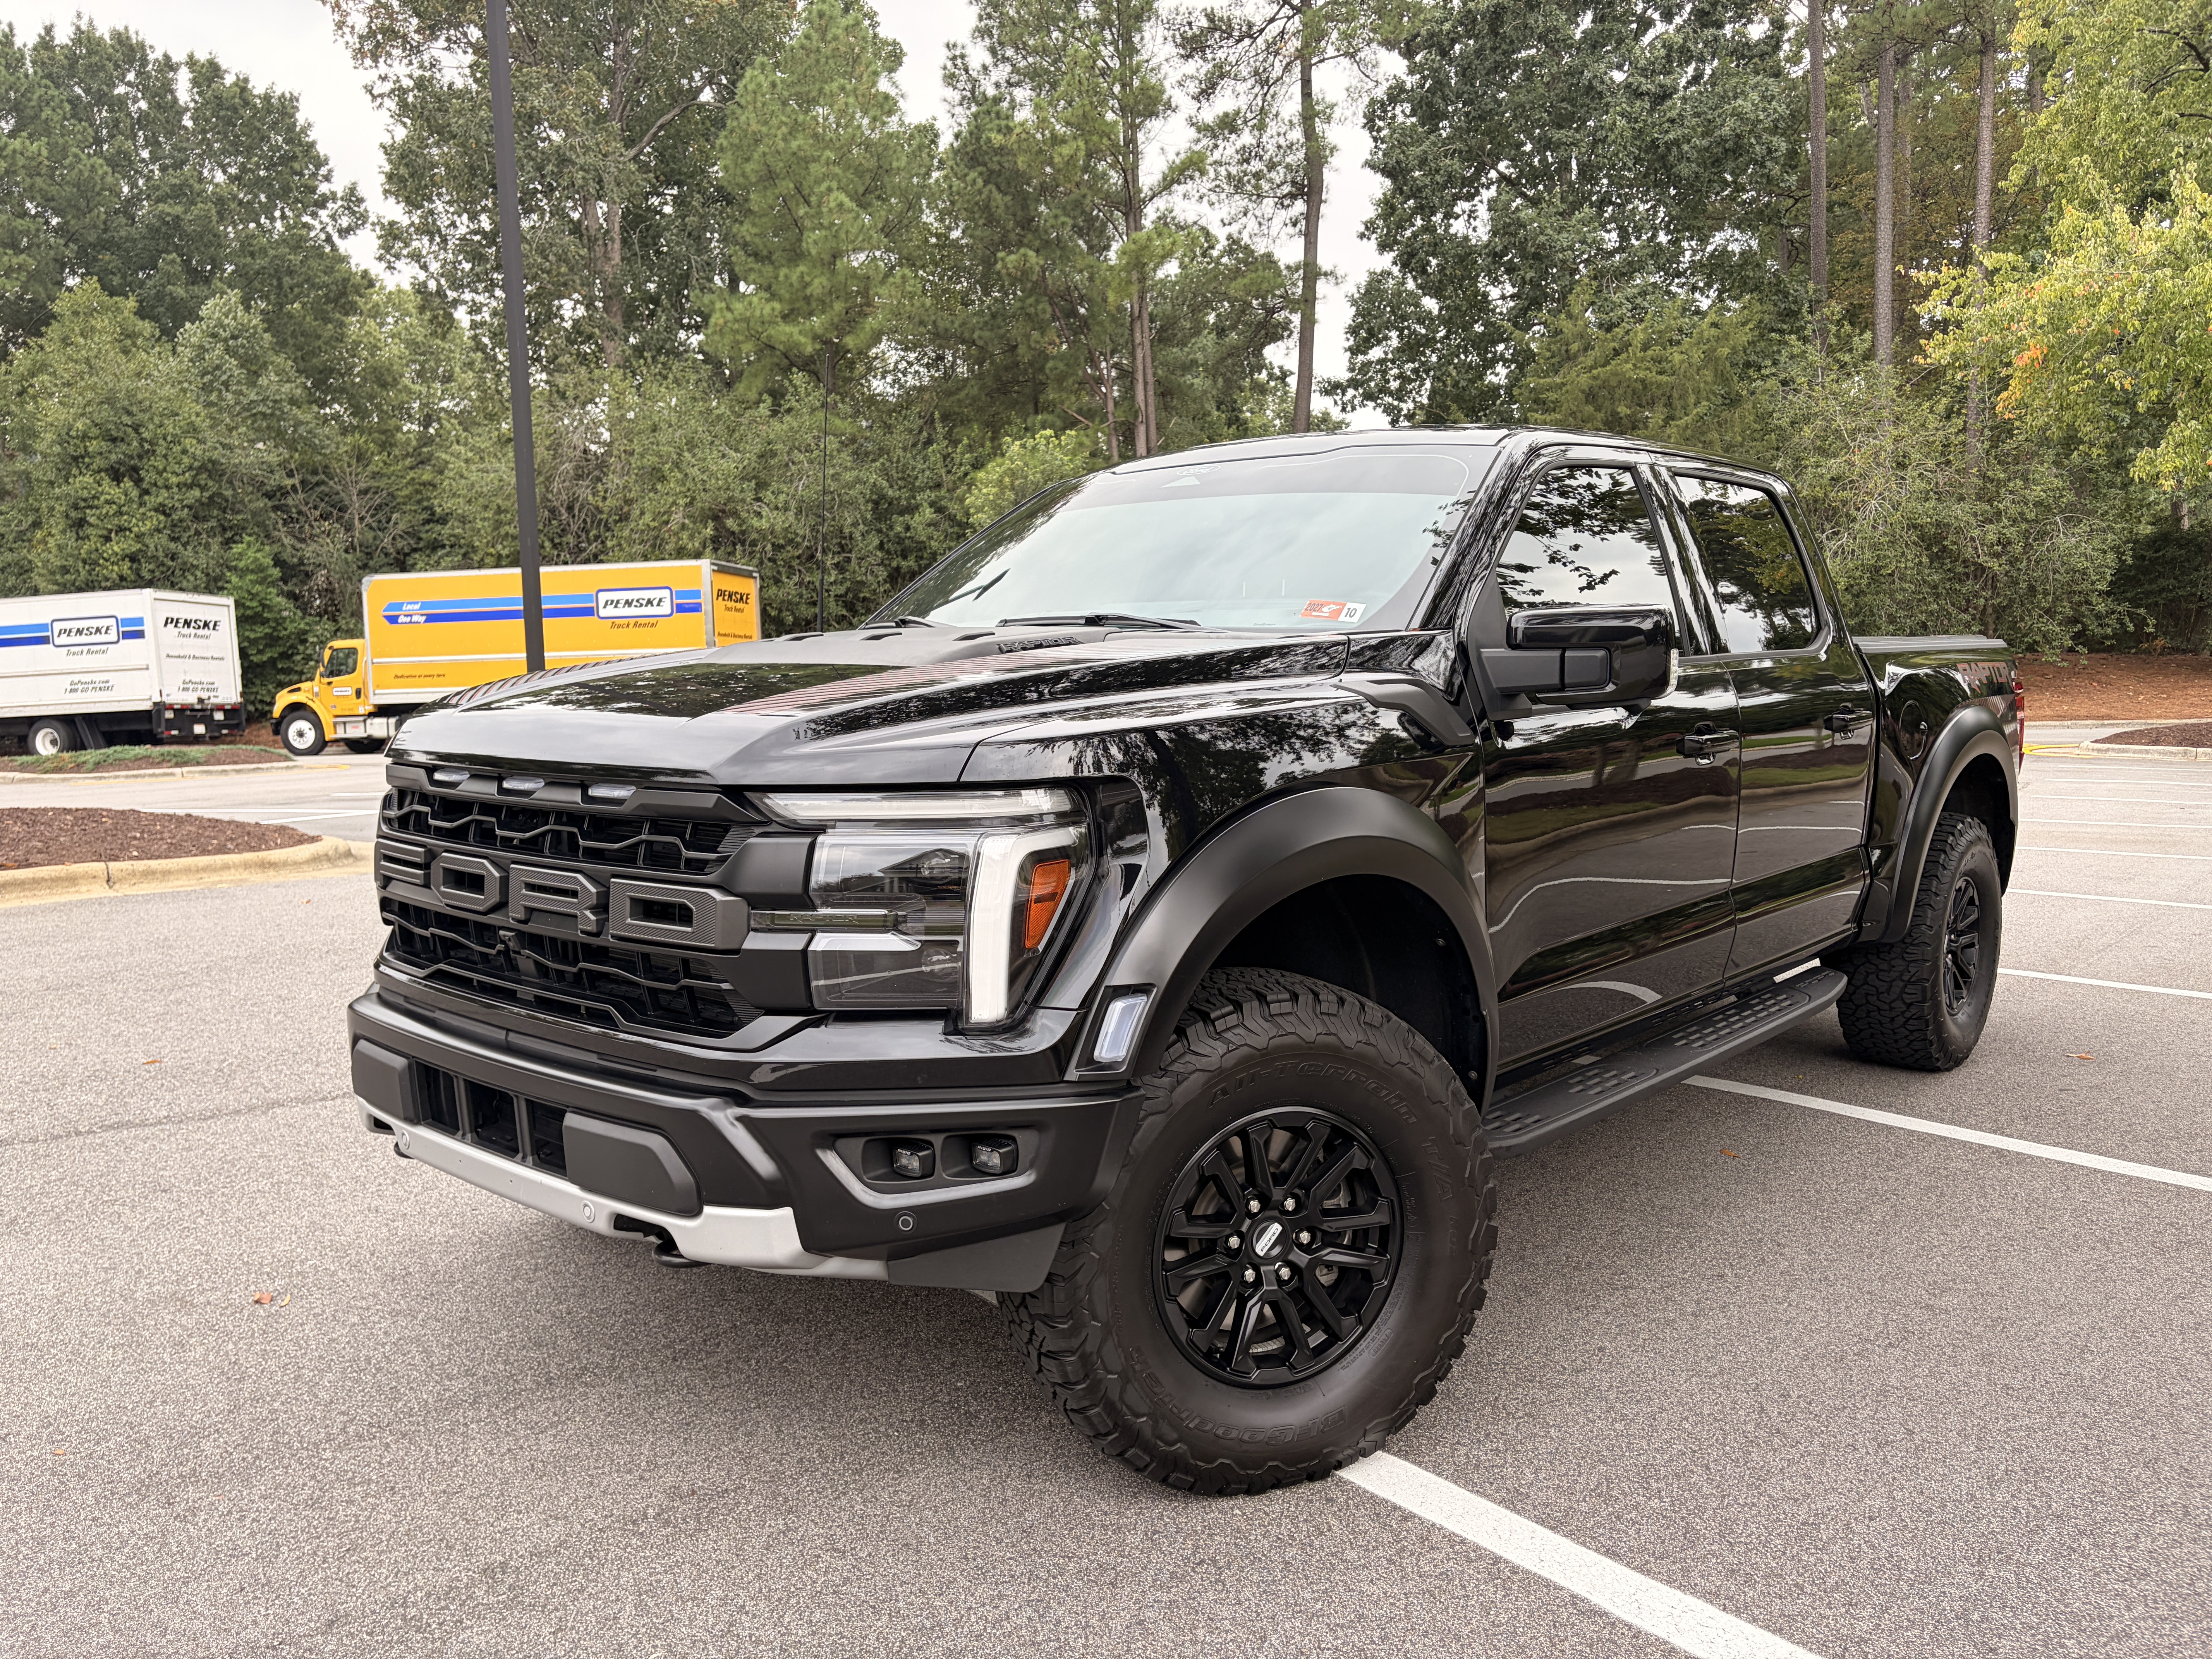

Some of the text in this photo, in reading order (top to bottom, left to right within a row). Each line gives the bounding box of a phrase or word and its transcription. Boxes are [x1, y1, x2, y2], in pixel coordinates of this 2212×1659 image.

[602, 597, 667, 610] PENSKE
[716, 588, 751, 605] PENSKE
[402, 601, 421, 611] Local
[724, 604, 733, 612] Truck
[1305, 603, 1357, 618] 2027 10
[163, 617, 222, 631] PENSKE
[398, 614, 426, 624] One Way
[610, 620, 659, 629] Truck Rental
[57, 624, 114, 638] PENSKE
[65, 647, 109, 657] Truck Rental
[996, 636, 1084, 654] RAPTOR
[1956, 662, 2014, 694] RAPTOR
[375, 838, 750, 951] FORD
[790, 913, 859, 924] RAPTOR
[1207, 1060, 1420, 1125] All-Terrain
[1261, 1228, 1279, 1252] FORD
[1129, 1345, 1347, 1446] BFGoodrich
